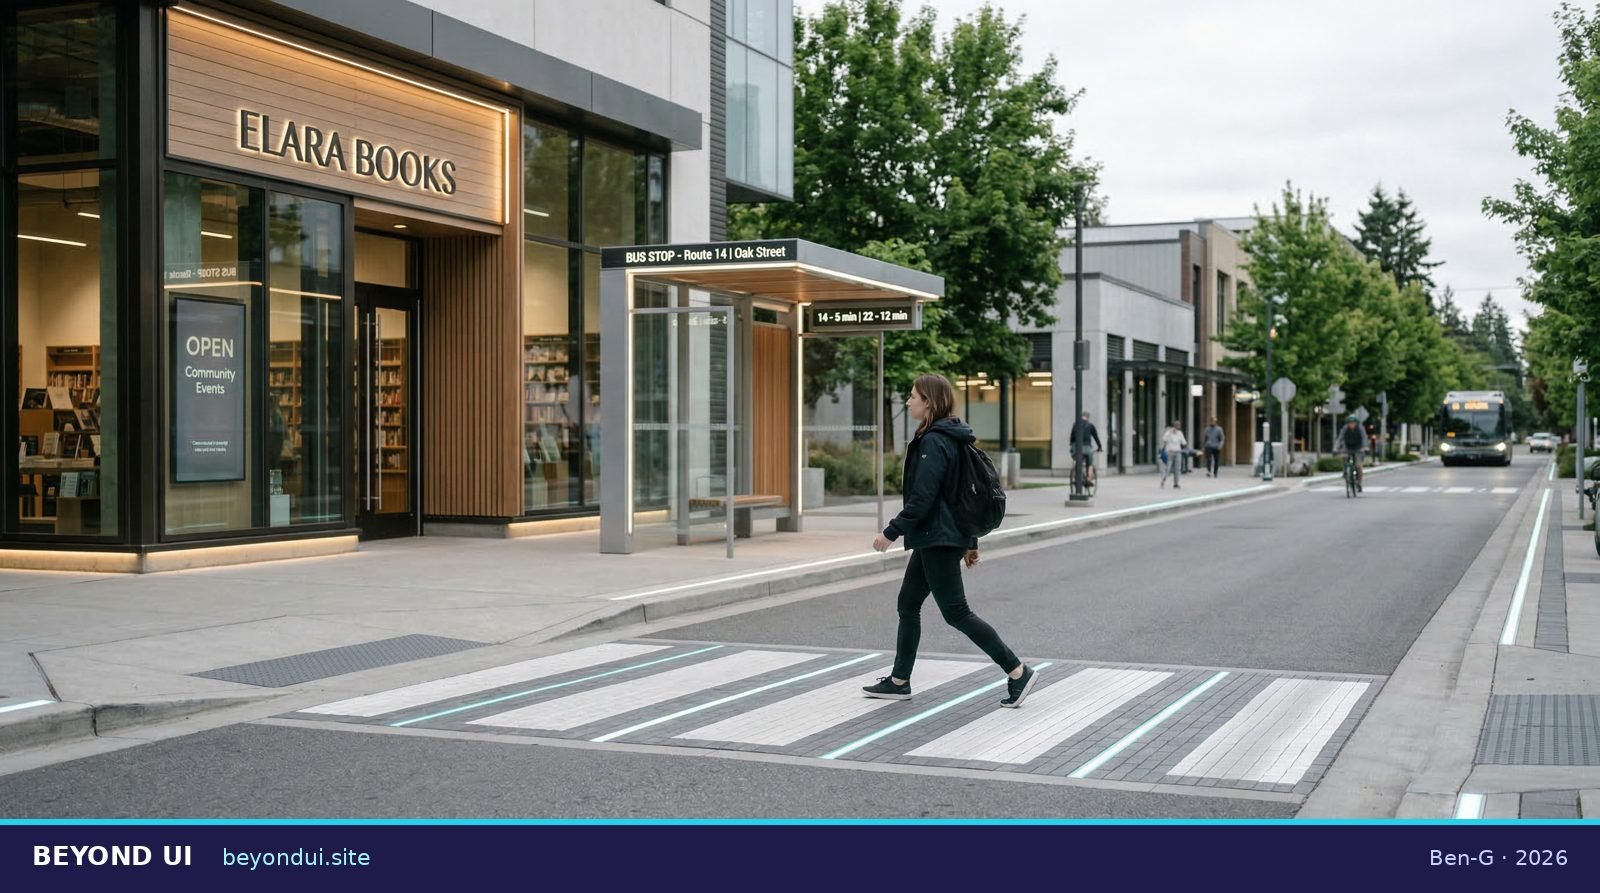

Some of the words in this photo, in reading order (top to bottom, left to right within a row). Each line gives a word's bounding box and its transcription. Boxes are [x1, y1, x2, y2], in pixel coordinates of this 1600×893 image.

[240, 109, 347, 171] ELARA
[355, 138, 457, 195] BOOKS
[625, 251, 647, 263] BUS
[648, 250, 675, 262] STOP
[684, 249, 713, 261] Route
[714, 248, 727, 260] 14
[734, 247, 754, 259] Oak
[755, 246, 786, 258] Street
[818, 312, 828, 322] 14
[834, 312, 841, 322] 5
[841, 311, 857, 322] min
[862, 311, 874, 321] 22
[880, 310, 891, 321] 12
[892, 310, 908, 320] min
[186, 336, 234, 358] OPEN
[185, 365, 236, 383] Community
[196, 382, 225, 394] Events
